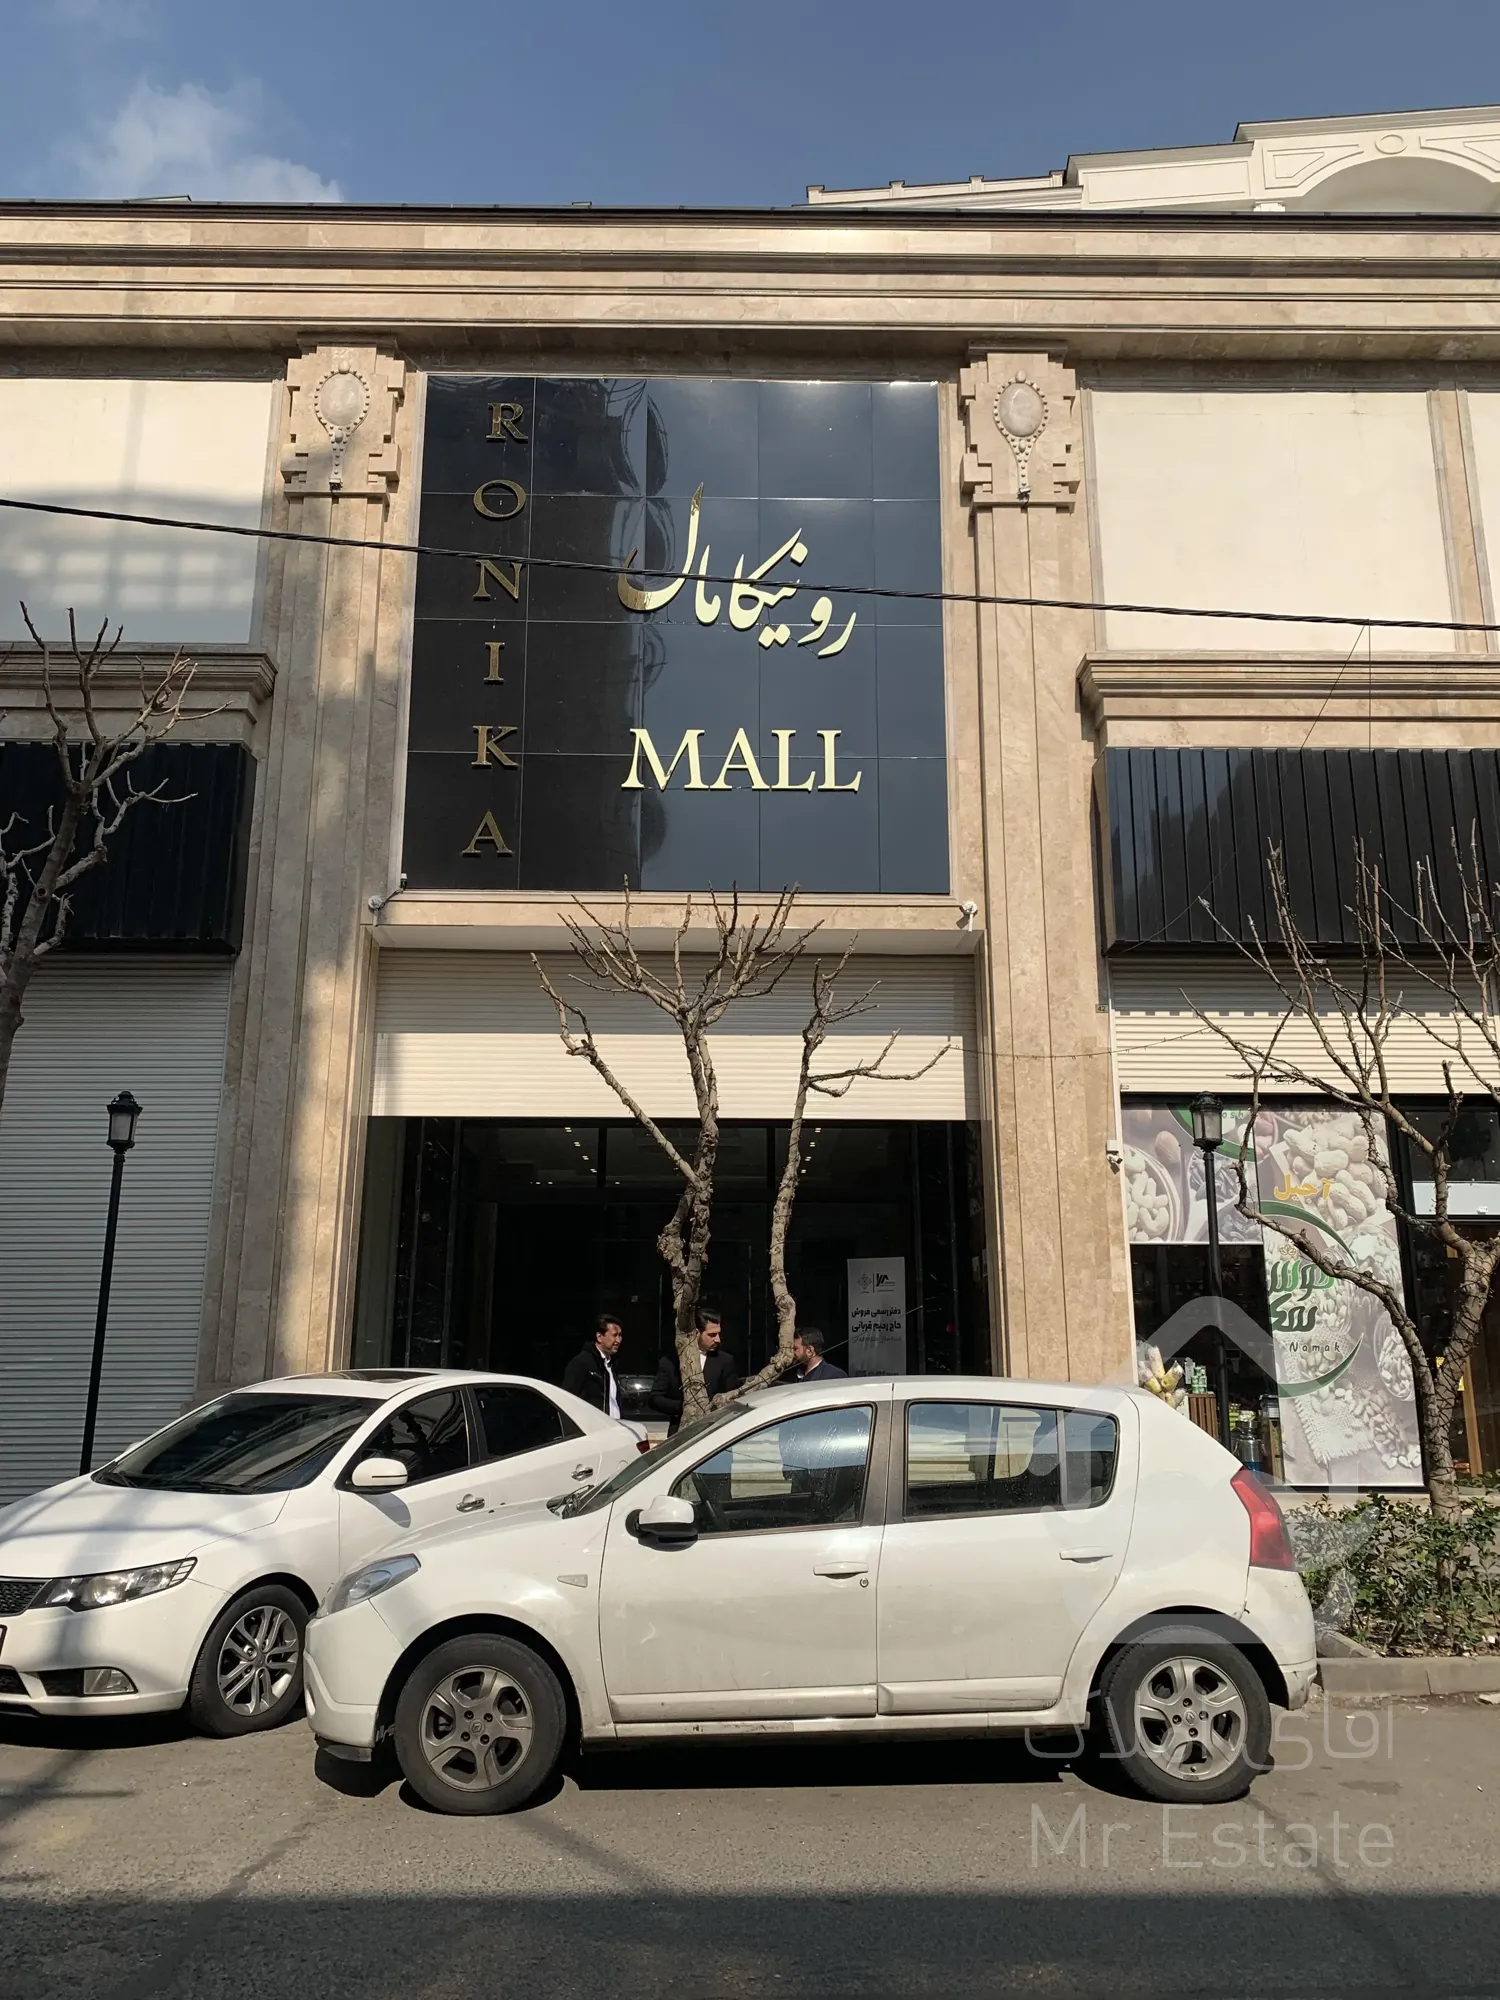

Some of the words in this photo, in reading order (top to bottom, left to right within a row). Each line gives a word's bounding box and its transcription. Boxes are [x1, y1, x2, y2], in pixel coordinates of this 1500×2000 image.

[461, 402, 528, 855] RONIKA
[621, 727, 862, 792] MALL
[1274, 1173, 1337, 1203] آجیل
[851, 1307, 871, 1318] فروش
[1289, 1341, 1341, 1353] Namak
